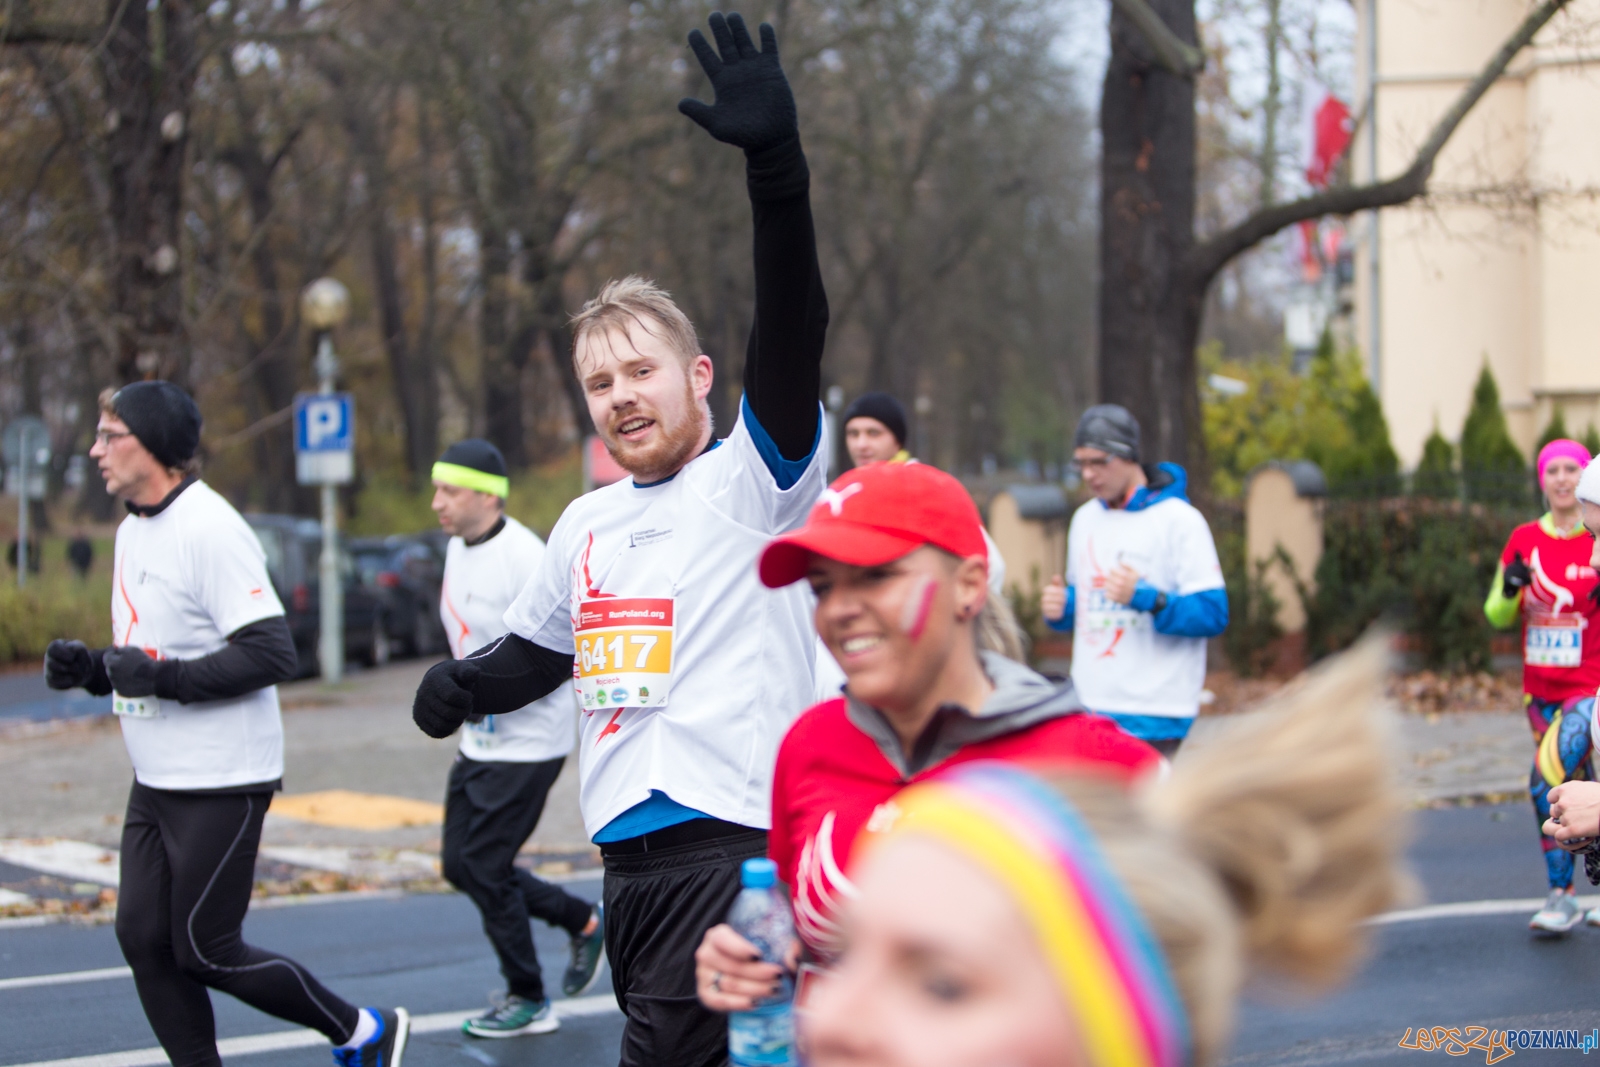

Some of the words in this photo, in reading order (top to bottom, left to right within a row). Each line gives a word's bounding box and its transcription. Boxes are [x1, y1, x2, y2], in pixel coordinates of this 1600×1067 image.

[306, 401, 342, 445] P
[609, 609, 665, 620] RunPoland.org
[581, 634, 658, 673] 6417
